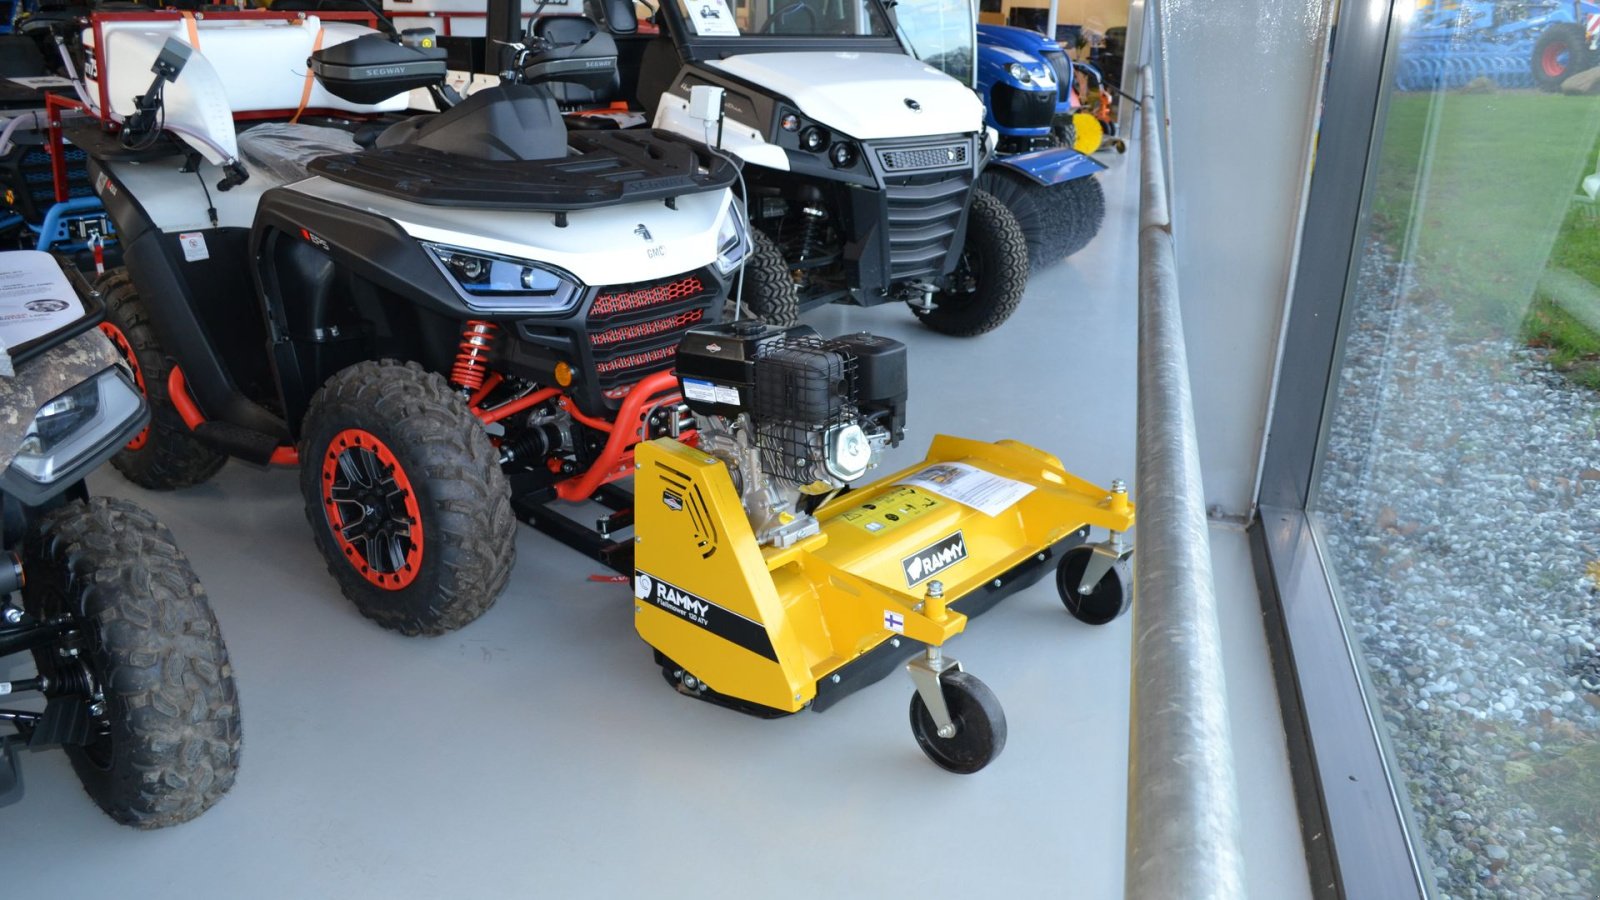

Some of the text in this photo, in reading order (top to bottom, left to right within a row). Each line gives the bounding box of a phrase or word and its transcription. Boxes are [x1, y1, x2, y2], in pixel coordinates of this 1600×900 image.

[585, 60, 612, 68] SEGWAY
[366, 66, 406, 76] SEGWAY
[921, 540, 963, 575] RAMMY
[657, 582, 709, 618] RAMMY
[697, 616, 709, 626] ATV
